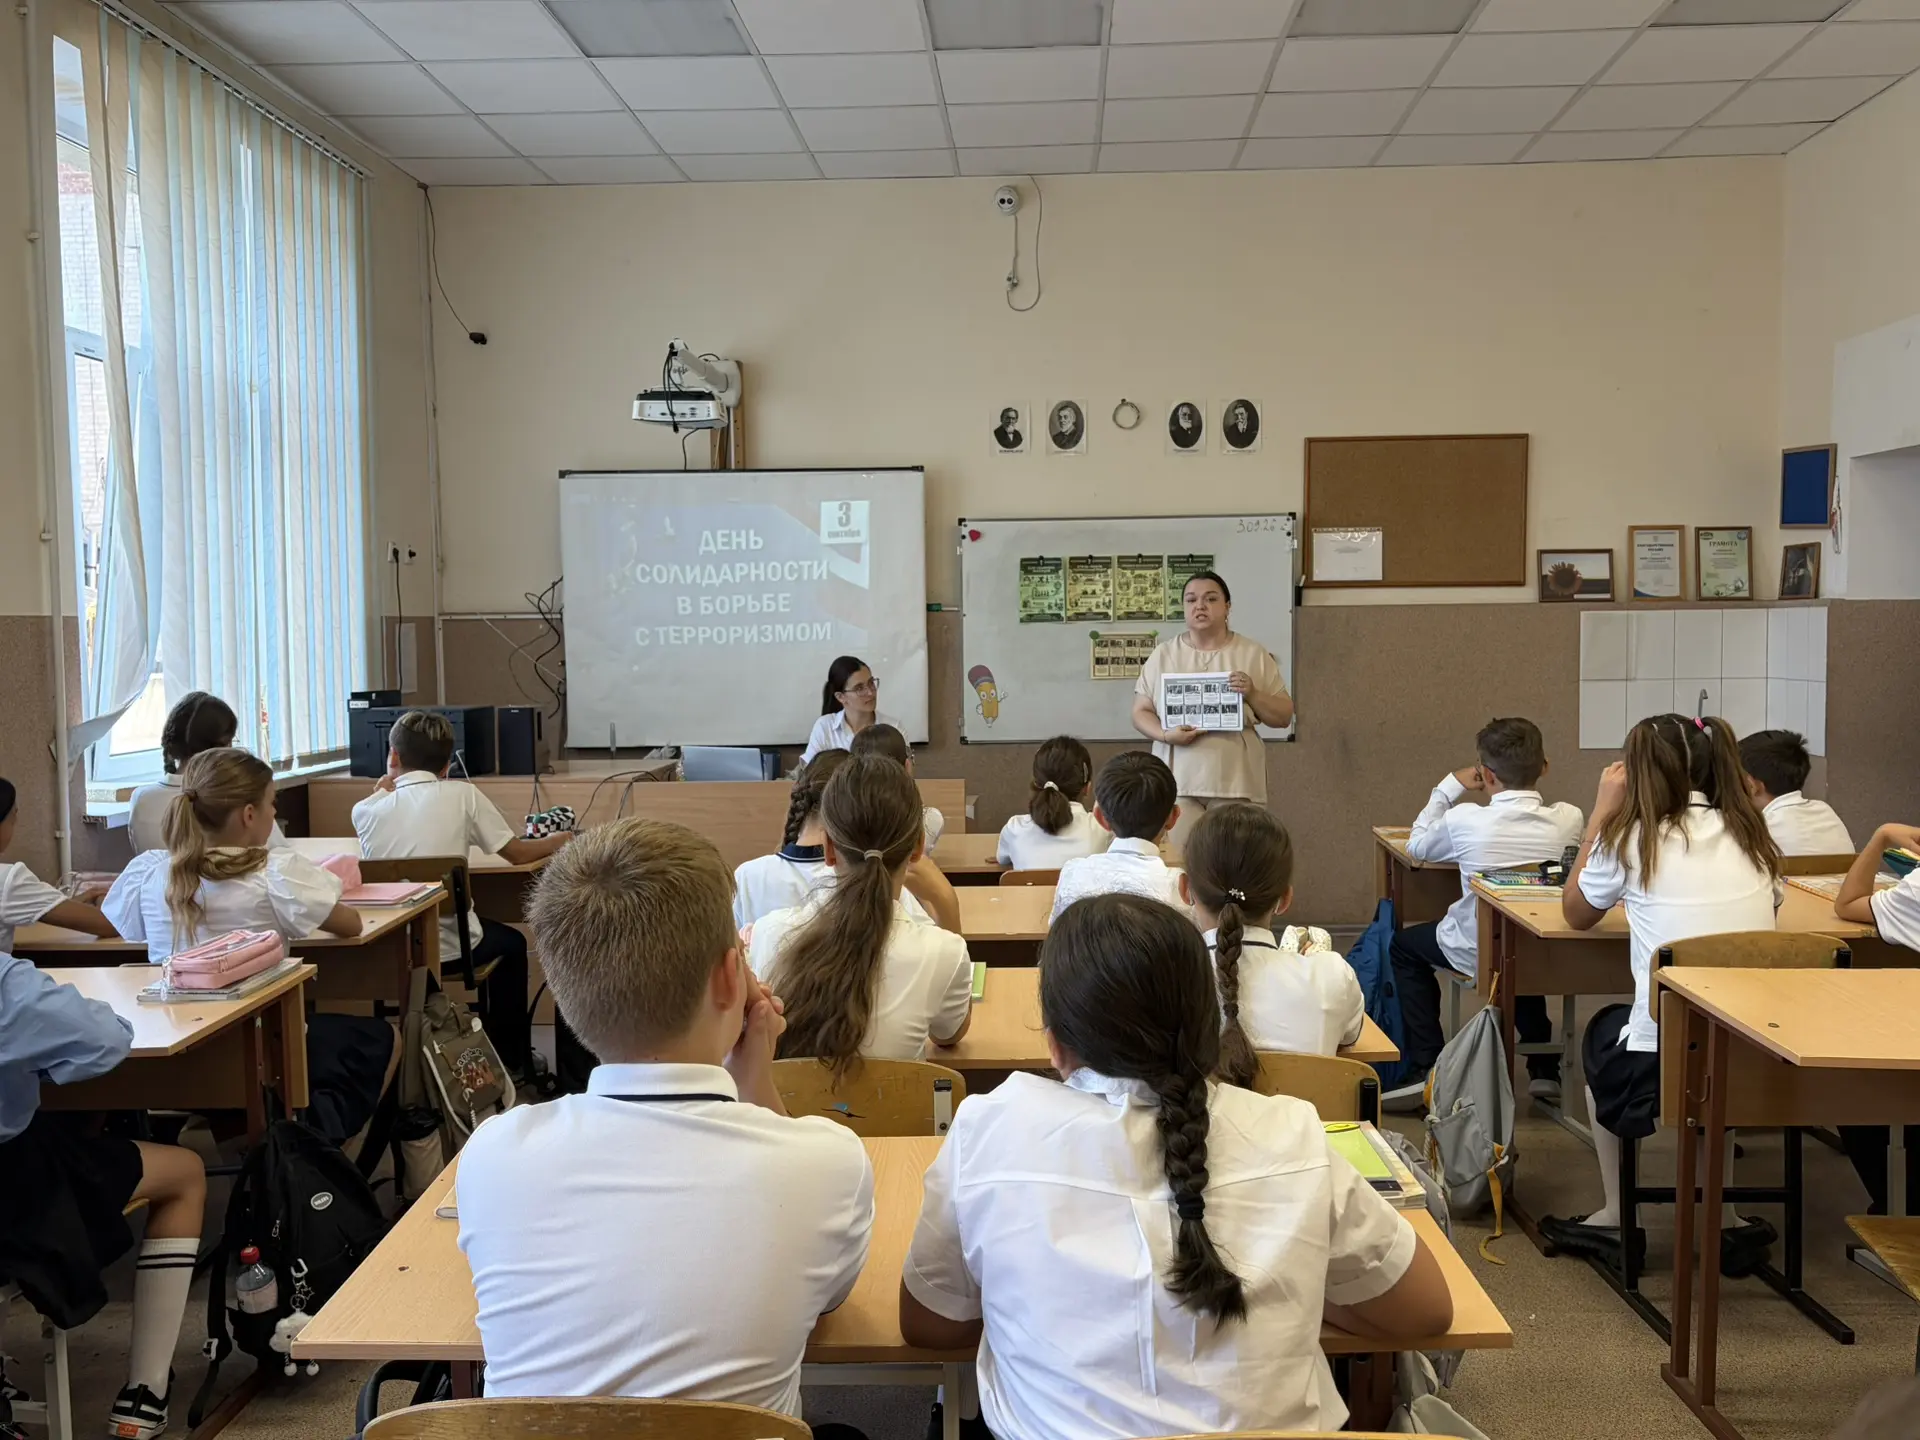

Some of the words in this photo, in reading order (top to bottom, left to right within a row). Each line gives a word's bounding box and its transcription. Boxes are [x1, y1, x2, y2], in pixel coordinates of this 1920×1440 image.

[838, 501, 852, 528] 3
[699, 528, 764, 556] ДЕНЬ
[635, 559, 829, 588] СОЛИДАРНОСТИ
[676, 595, 693, 615] В
[699, 592, 792, 615] БОРЬБЕ
[635, 626, 650, 646] С
[654, 621, 833, 646] ТЕРРОРИЗМОМ
